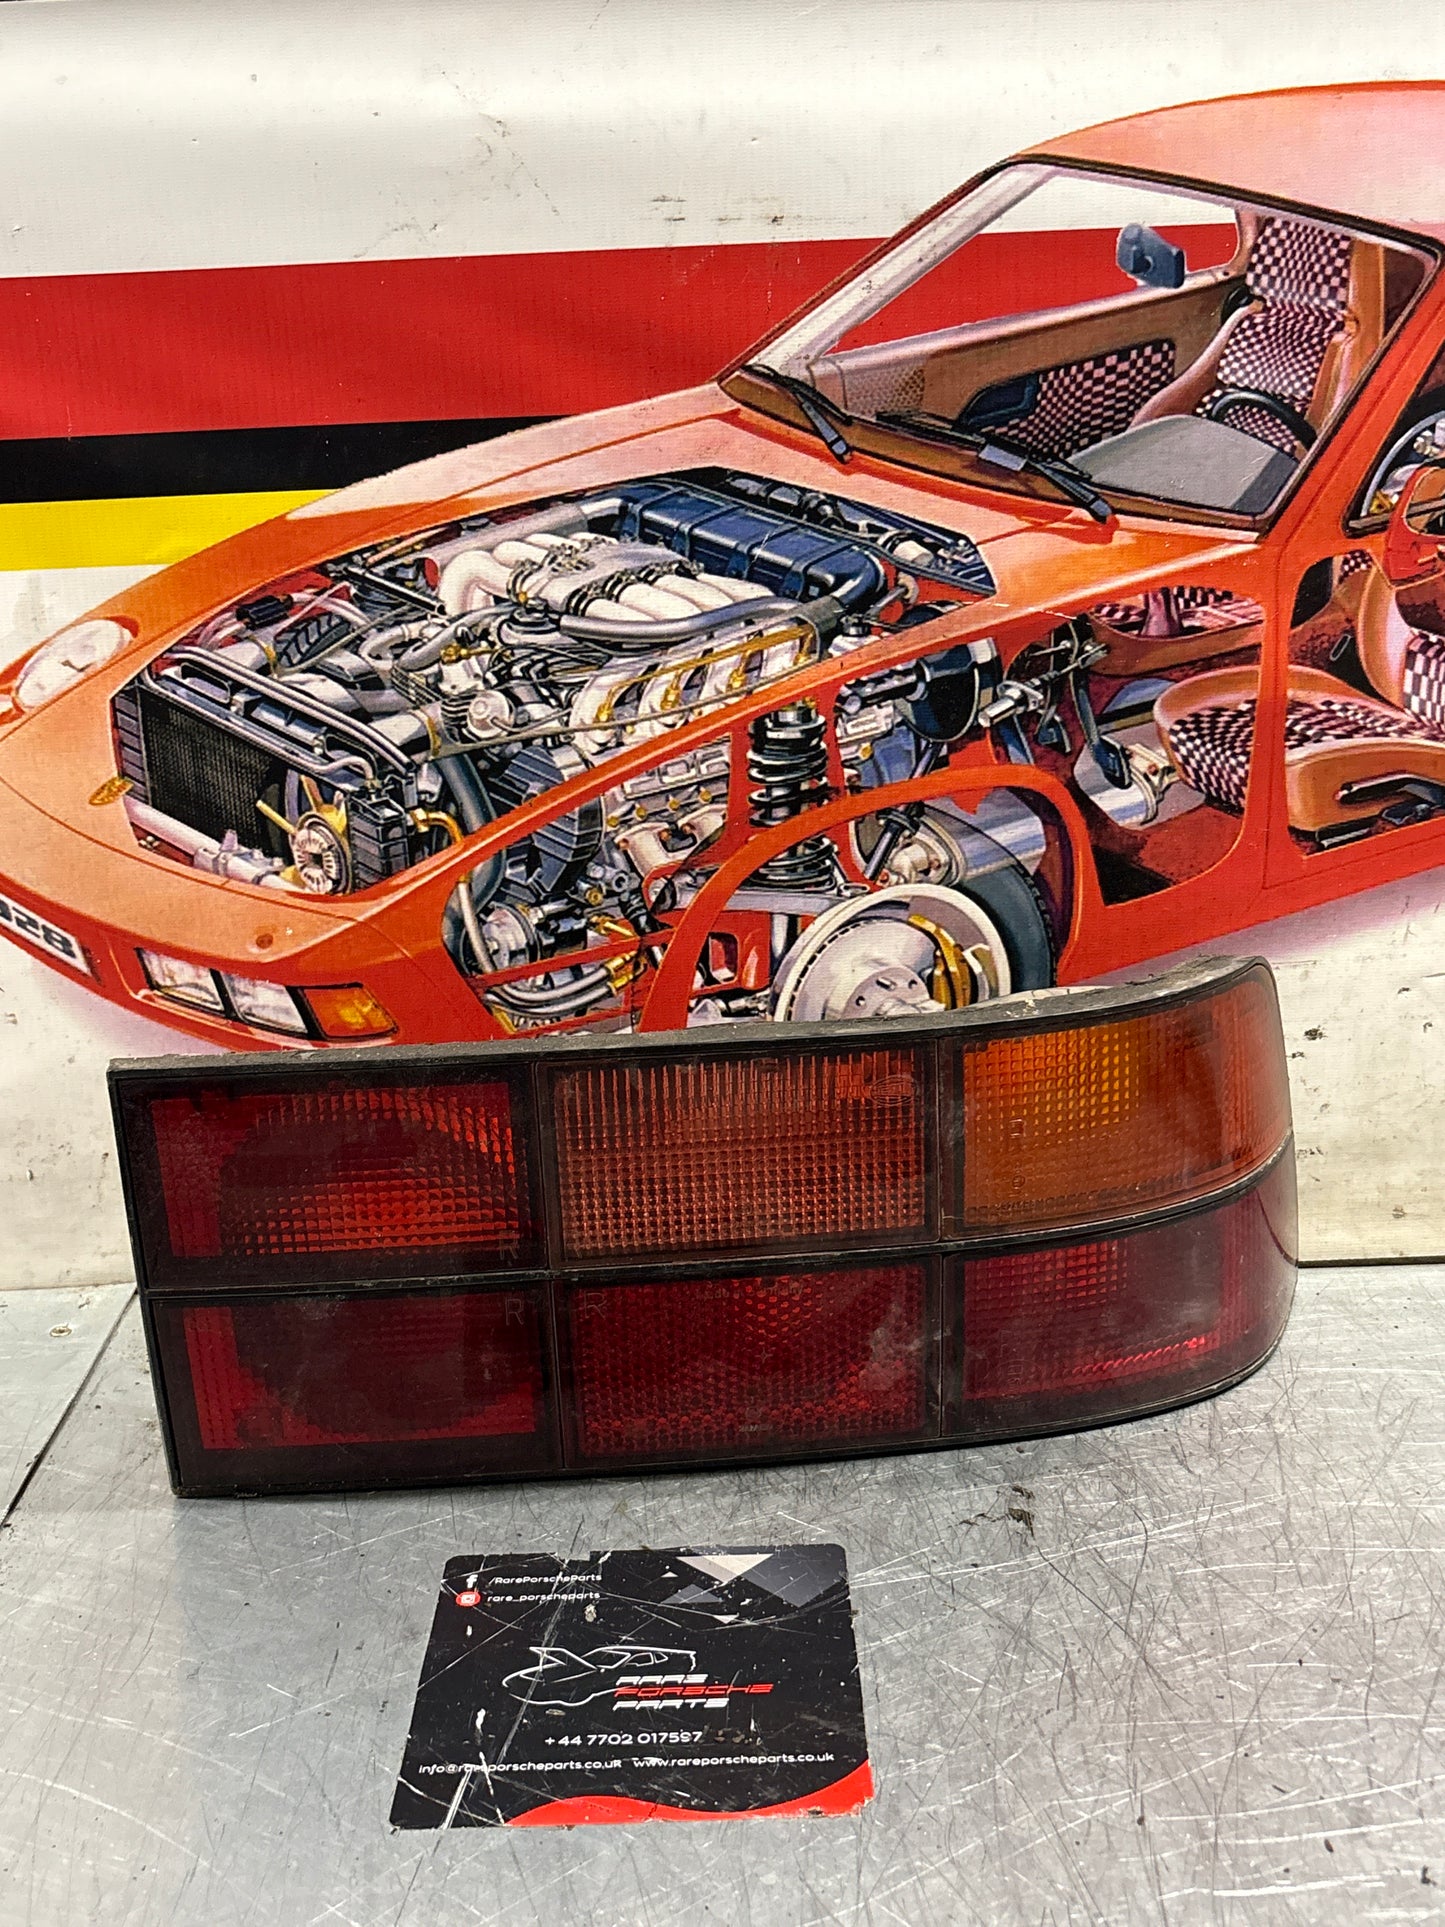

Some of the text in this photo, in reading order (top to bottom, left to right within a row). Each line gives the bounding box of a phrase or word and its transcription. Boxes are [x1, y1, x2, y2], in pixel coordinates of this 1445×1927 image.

[614, 1684, 774, 1698] PORSCHE
[612, 1698, 729, 1711] PARTS
[587, 1734, 633, 1745] 7702
[637, 1731, 703, 1744] 017597
[633, 1752, 834, 1768] www.rareporscheparts.co.uk
